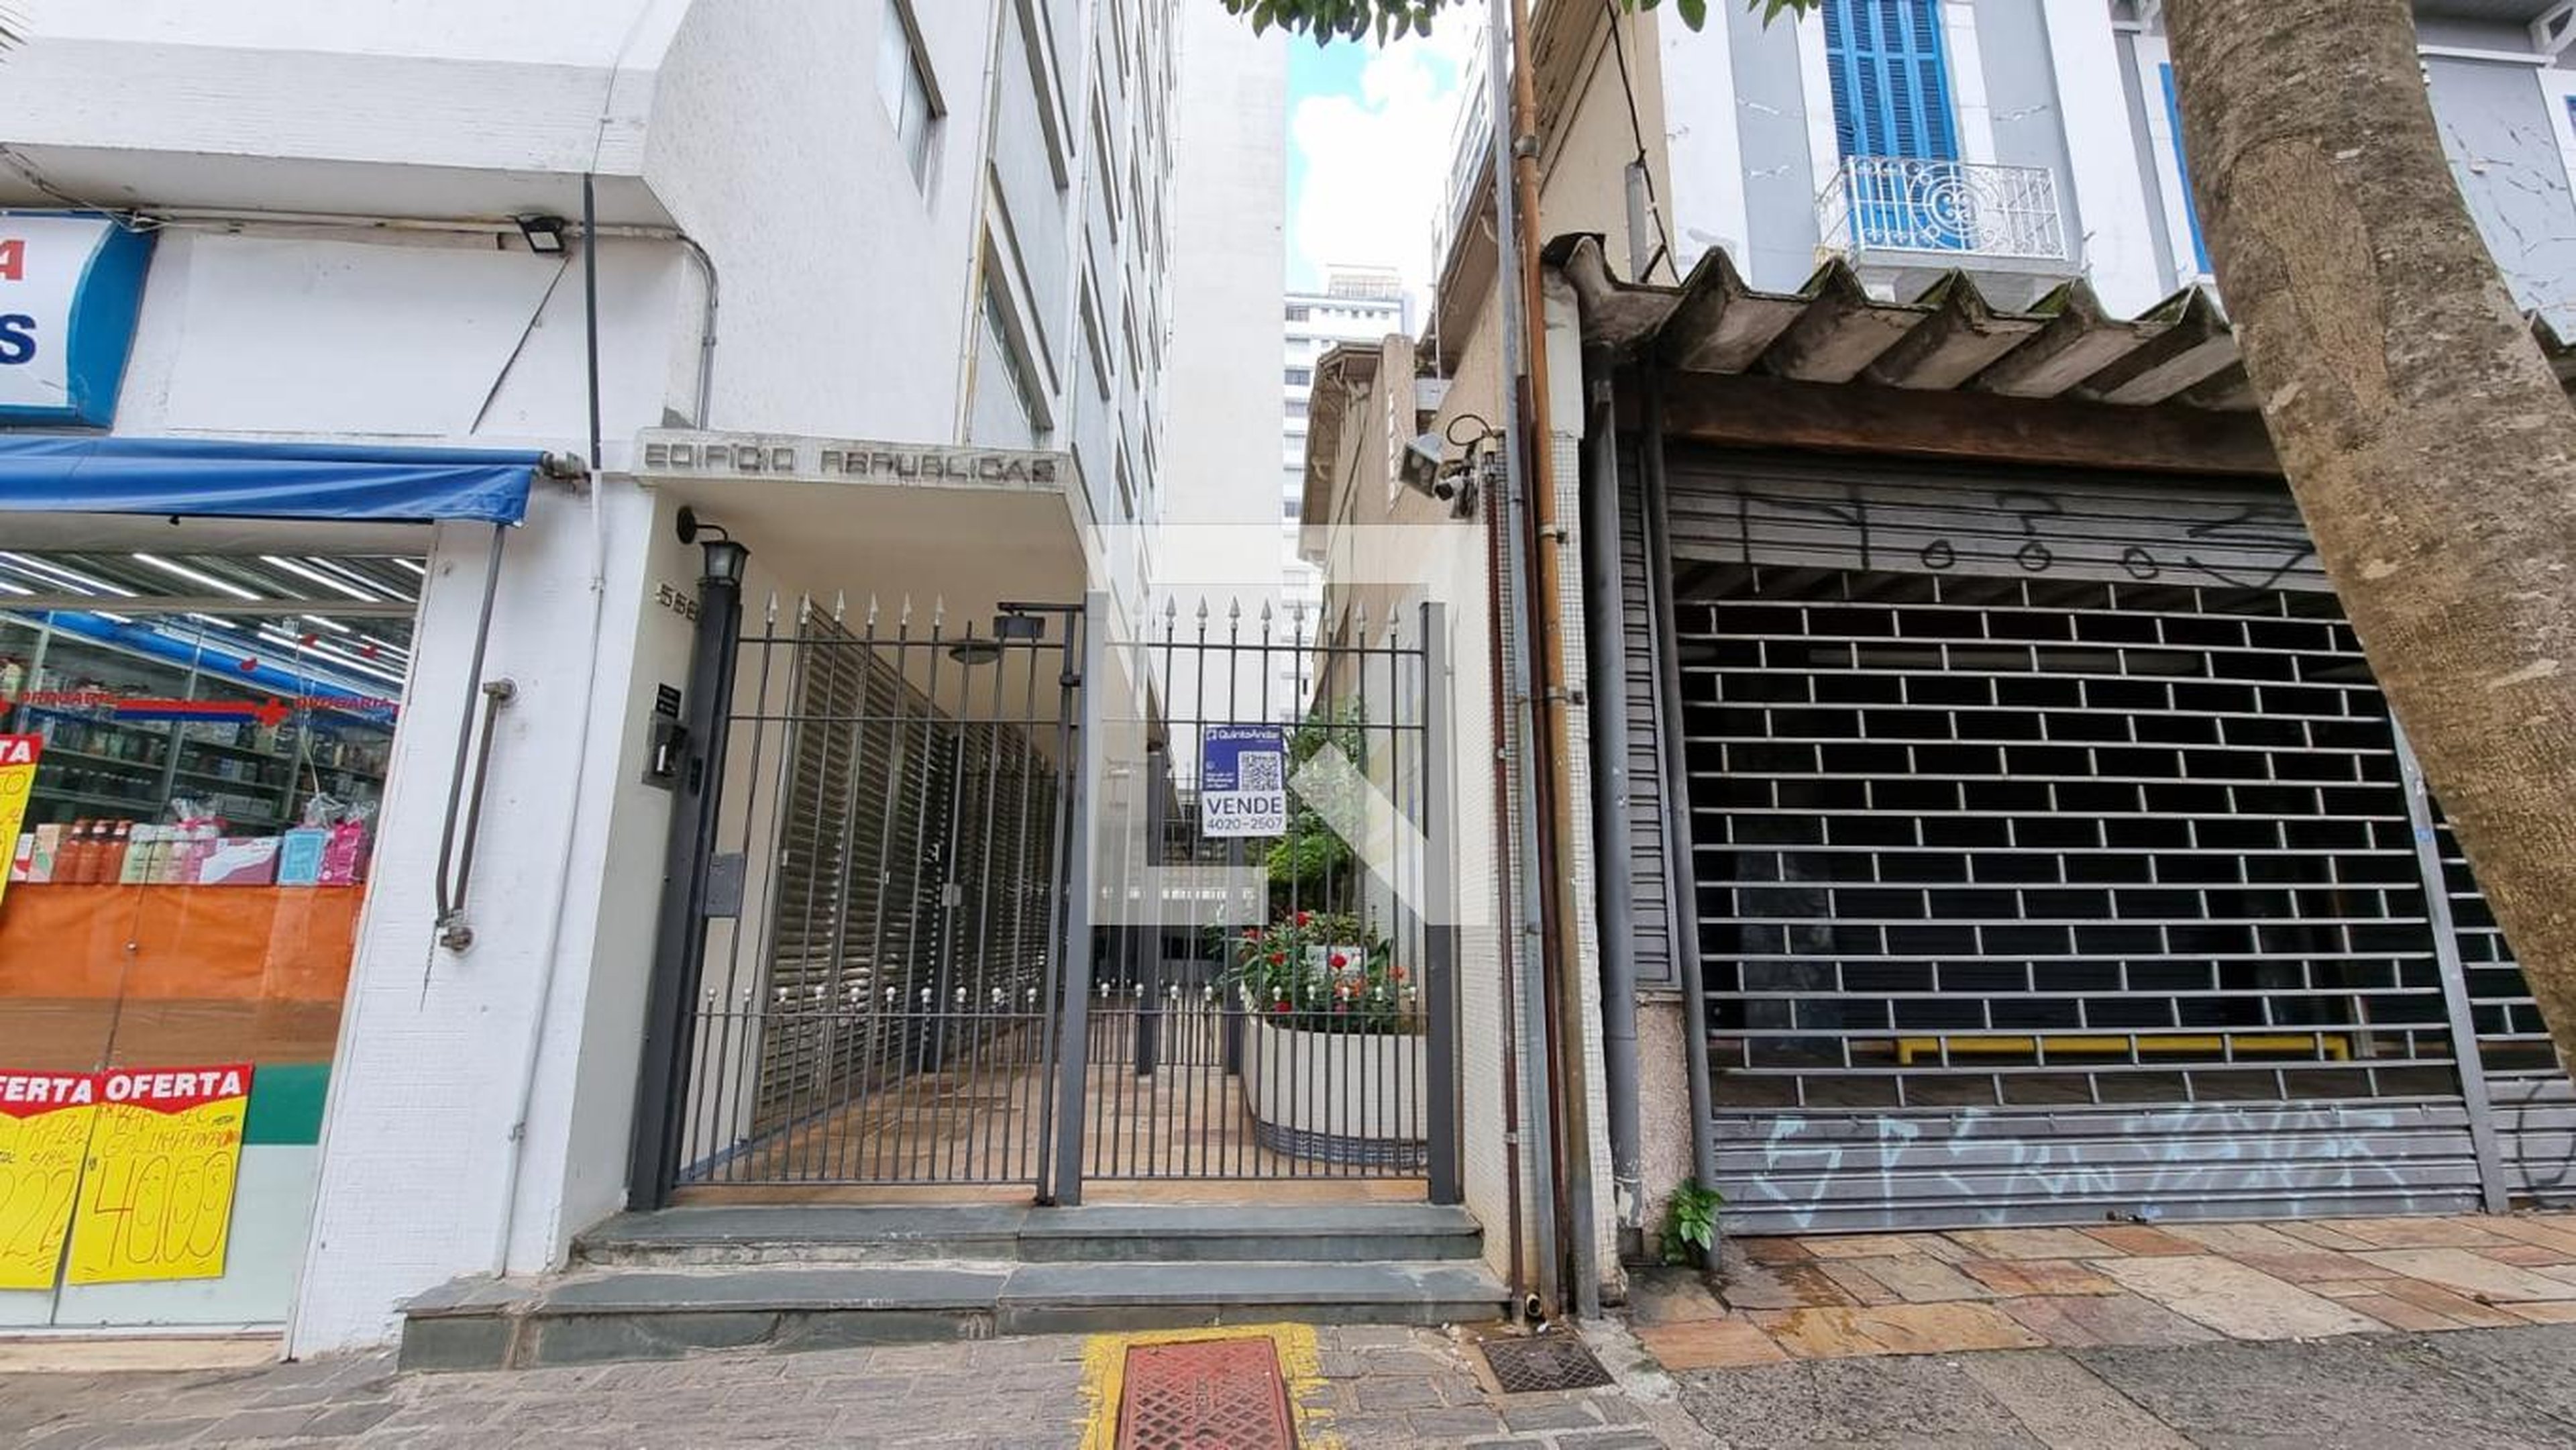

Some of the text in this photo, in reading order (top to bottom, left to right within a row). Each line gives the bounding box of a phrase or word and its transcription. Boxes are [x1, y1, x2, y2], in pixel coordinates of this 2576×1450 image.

[1208, 796, 1283, 815] VENDE
[1208, 817, 1282, 830] 4020-2507
[105, 1072, 241, 1101] OFERTA
